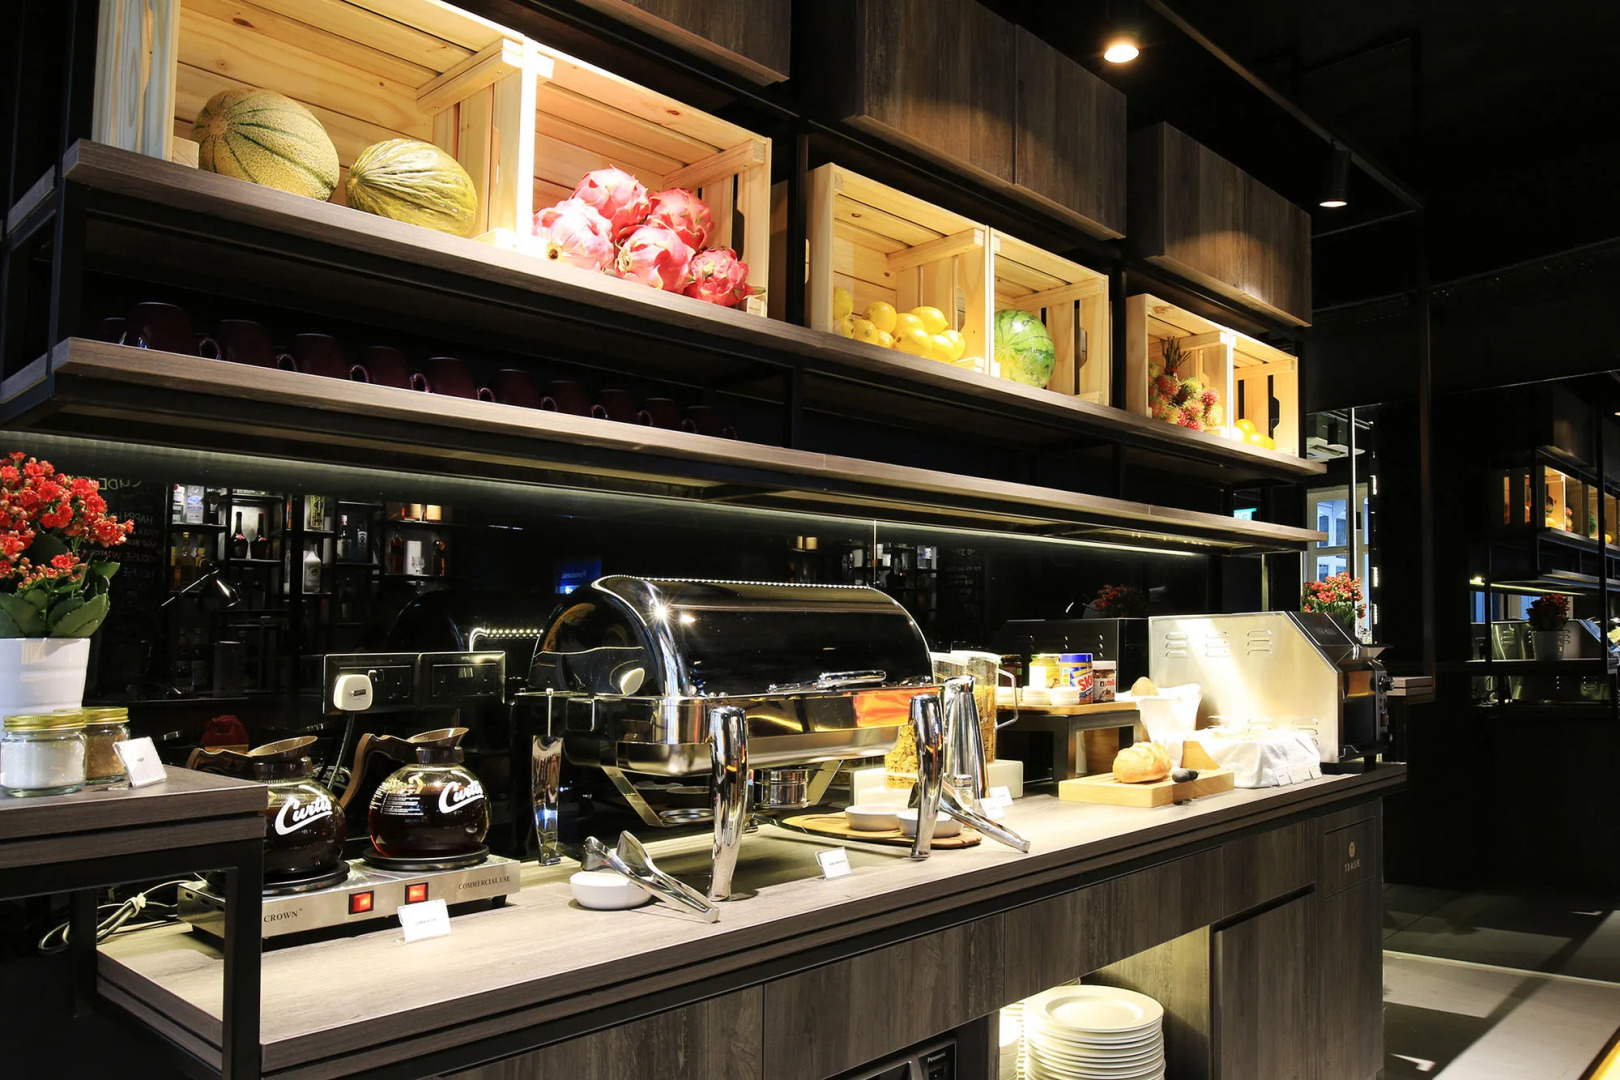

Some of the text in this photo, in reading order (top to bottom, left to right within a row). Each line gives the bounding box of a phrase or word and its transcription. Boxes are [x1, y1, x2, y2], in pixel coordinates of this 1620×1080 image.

[275, 784, 333, 836] Curtis
[1344, 859, 1361, 873] TRASH
[458, 875, 511, 890] COMMERCIAL USE
[263, 910, 299, 923] CROWN
